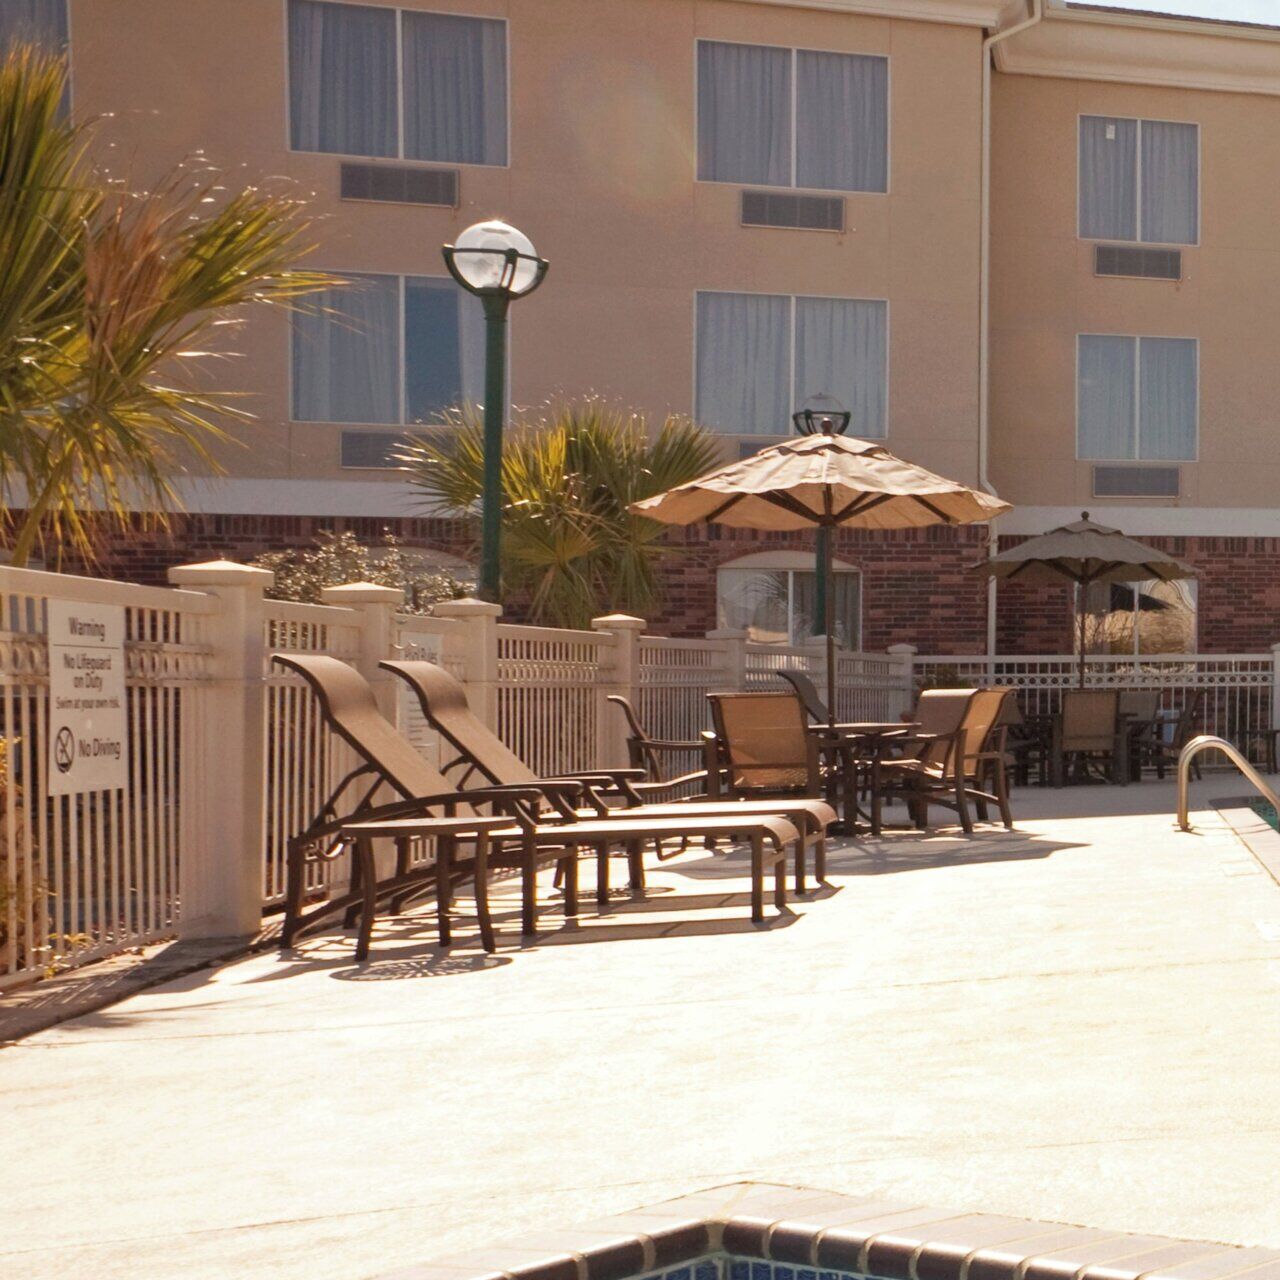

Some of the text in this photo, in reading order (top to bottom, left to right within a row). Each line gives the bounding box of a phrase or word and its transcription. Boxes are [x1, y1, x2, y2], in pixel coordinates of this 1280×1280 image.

[67, 617, 105, 641] Warning
[63, 653, 111, 674] No Lifeguard
[73, 672, 103, 692] on Duty
[56, 696, 73, 709] Swim
[74, 698, 80, 709] at
[81, 699, 94, 712] your
[79, 738, 120, 760] No Diving
